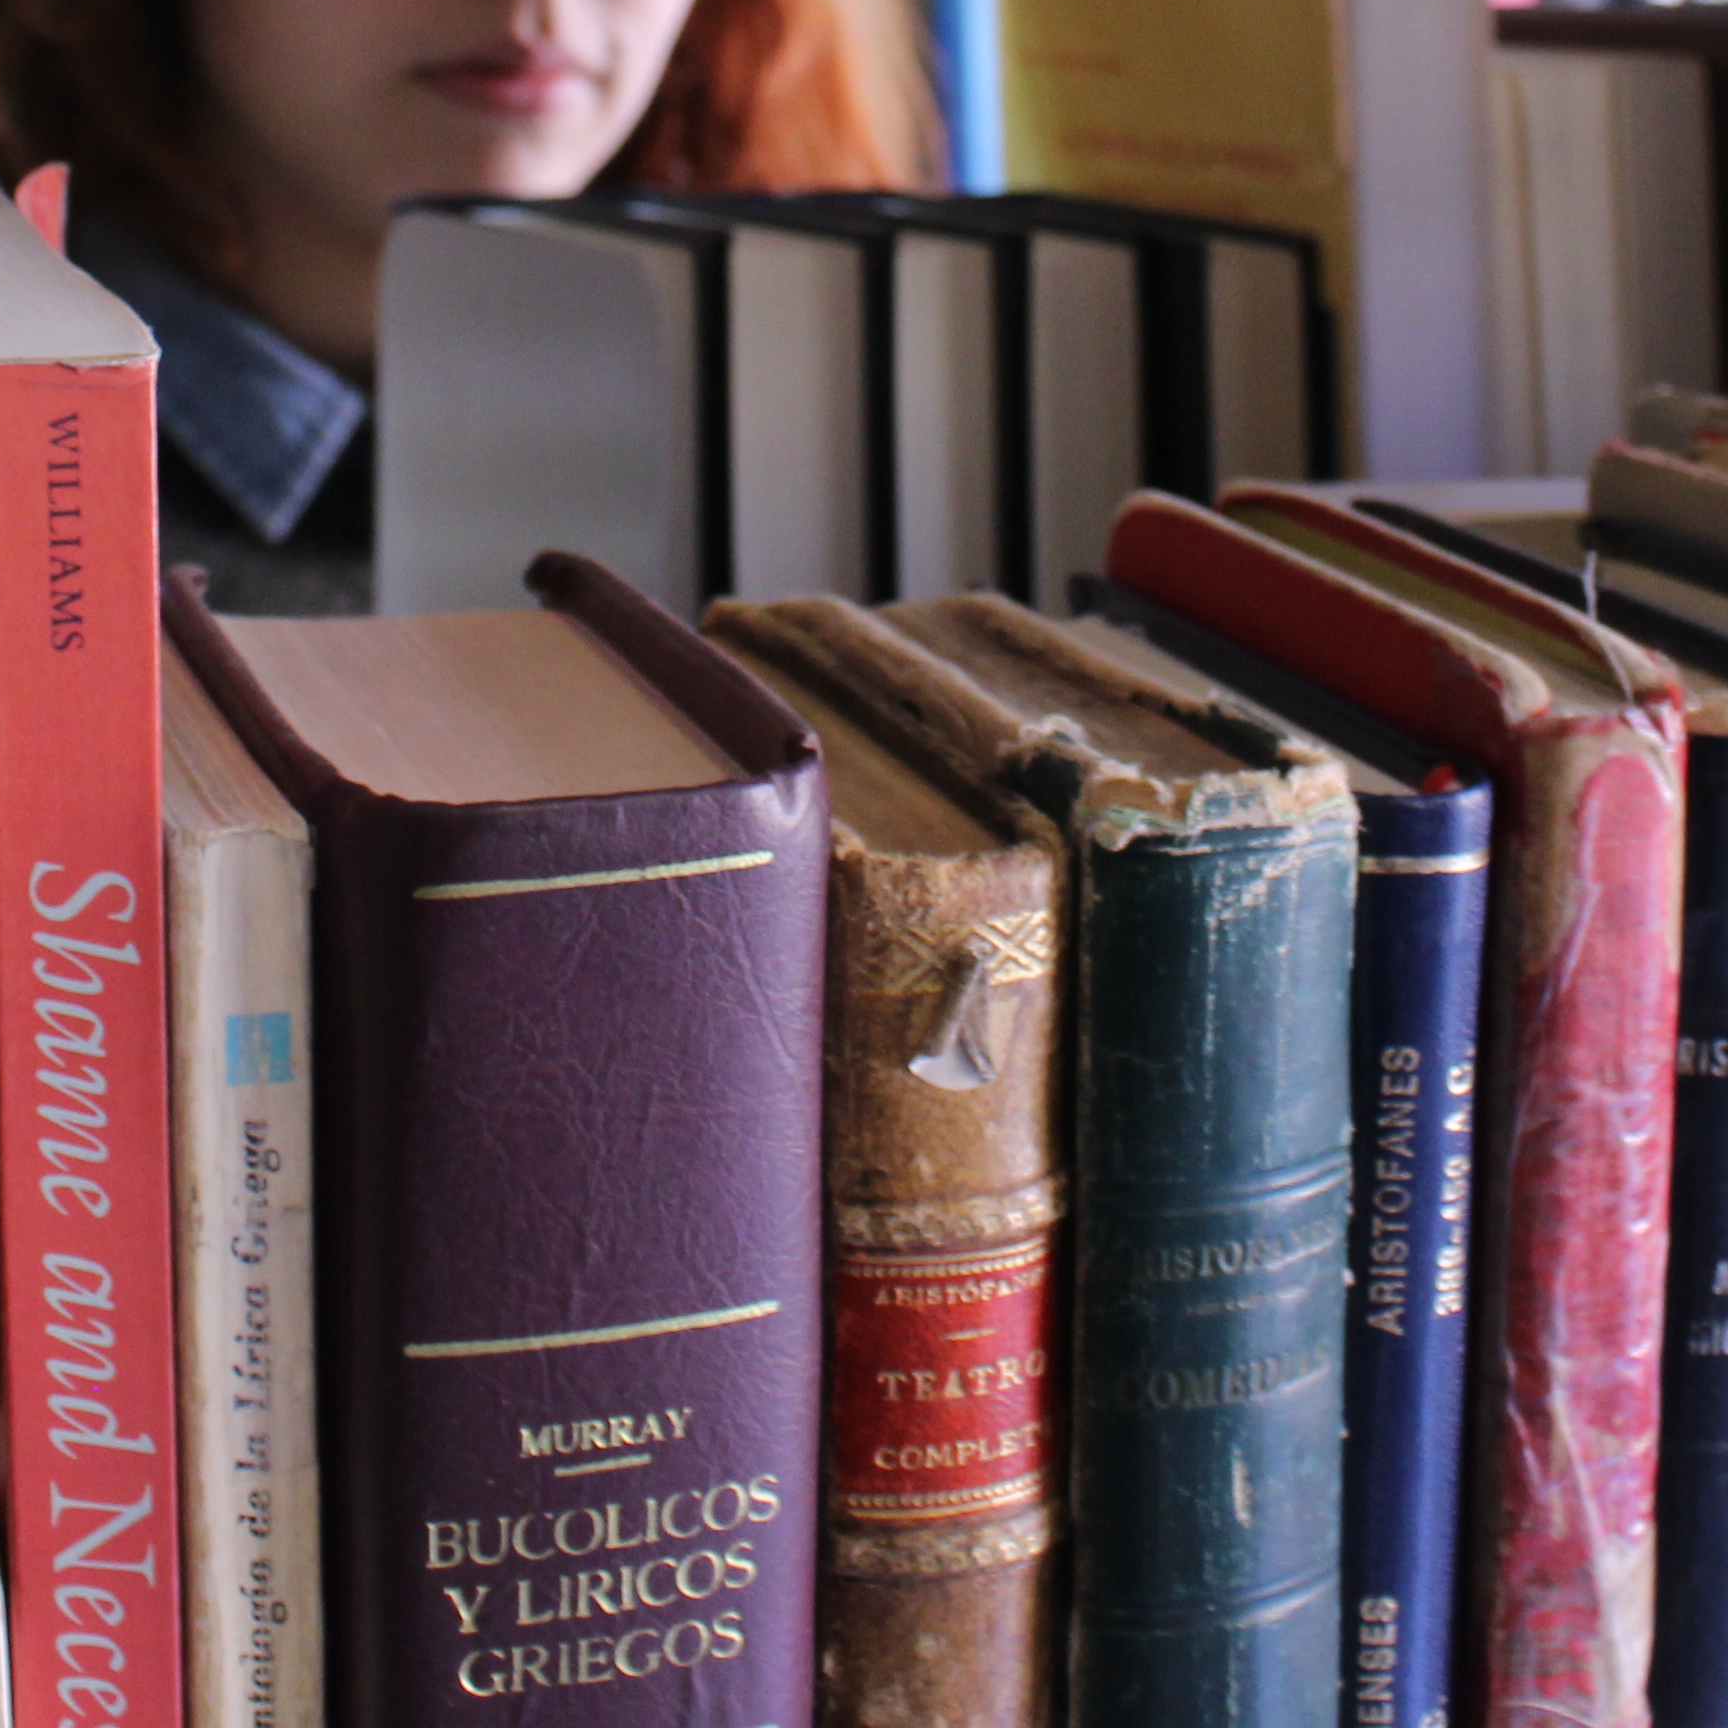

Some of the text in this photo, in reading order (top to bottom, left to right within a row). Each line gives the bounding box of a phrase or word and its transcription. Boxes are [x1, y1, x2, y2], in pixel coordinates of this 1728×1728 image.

[46, 412, 86, 653] WILLIAMS
[1366, 1045, 1422, 1338] ARISTOFANES
[29, 860, 158, 1728] Shame and Nece
[232, 1285, 271, 1412] Lírica
[876, 1348, 1046, 1402] TEATRO
[518, 1406, 694, 1459] MURRAY
[874, 1422, 1044, 1470] COMPLET
[237, 1487, 272, 1539] de
[424, 1473, 783, 1571] BUCOLICOS
[443, 1540, 759, 1635] Y LIRICOS
[457, 1610, 746, 1698] GRIEGOS
